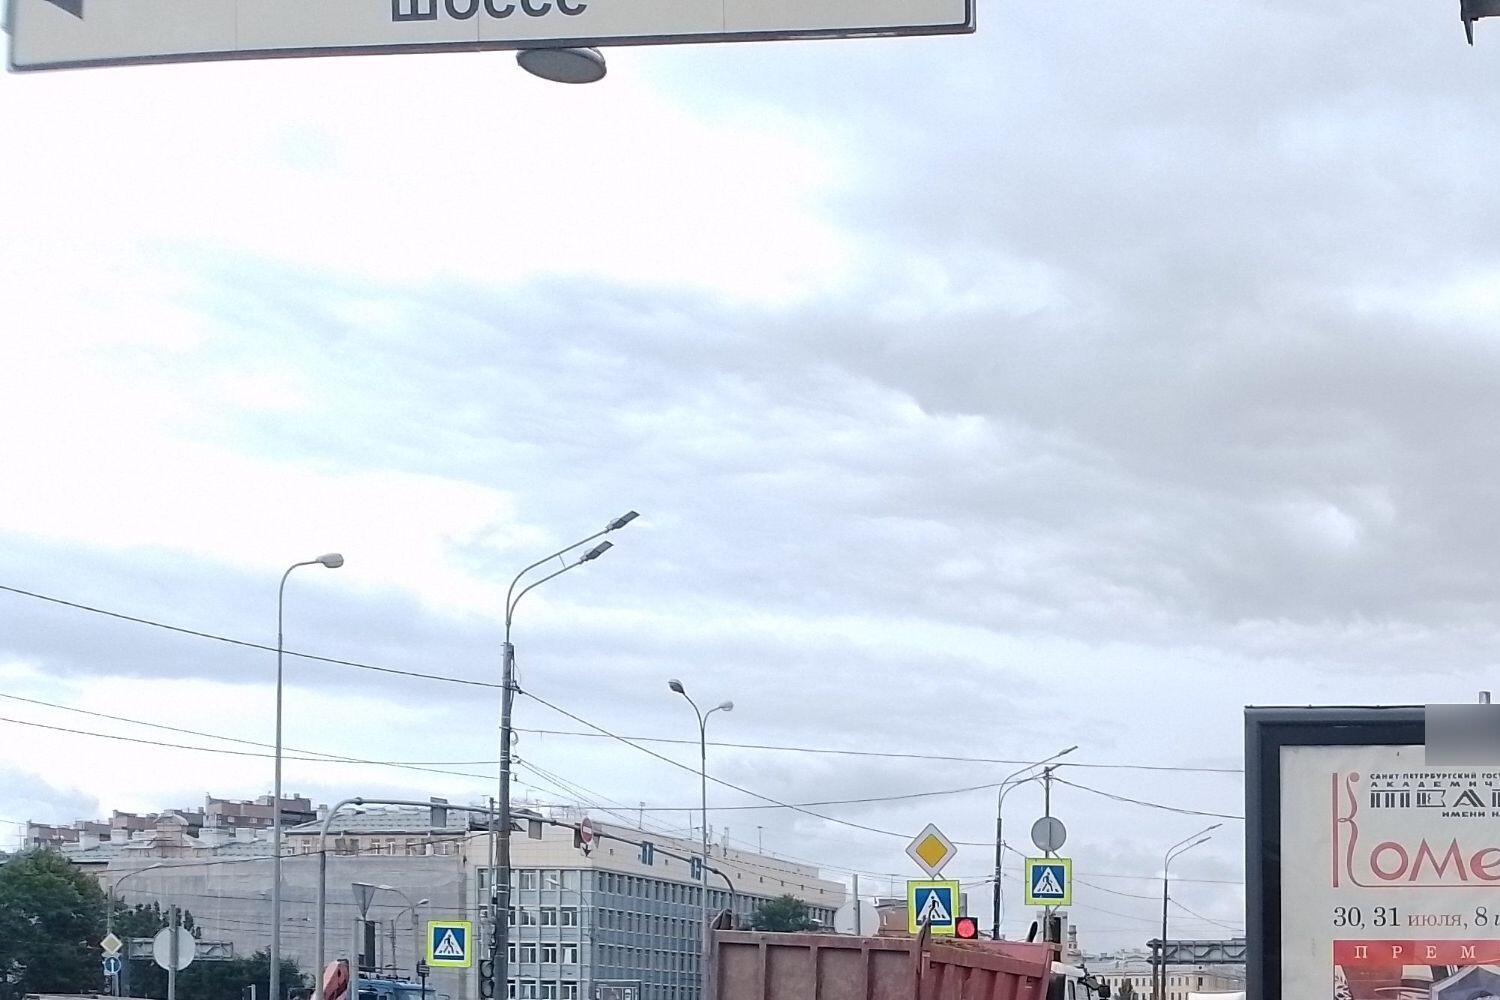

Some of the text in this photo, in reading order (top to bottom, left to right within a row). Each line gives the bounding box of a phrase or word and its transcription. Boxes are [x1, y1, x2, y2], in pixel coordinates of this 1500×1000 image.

[1333, 906, 1366, 930] 30,
[1373, 906, 1401, 927] 31
[1407, 912, 1469, 930] июля,
[1474, 906, 1488, 927] 8
